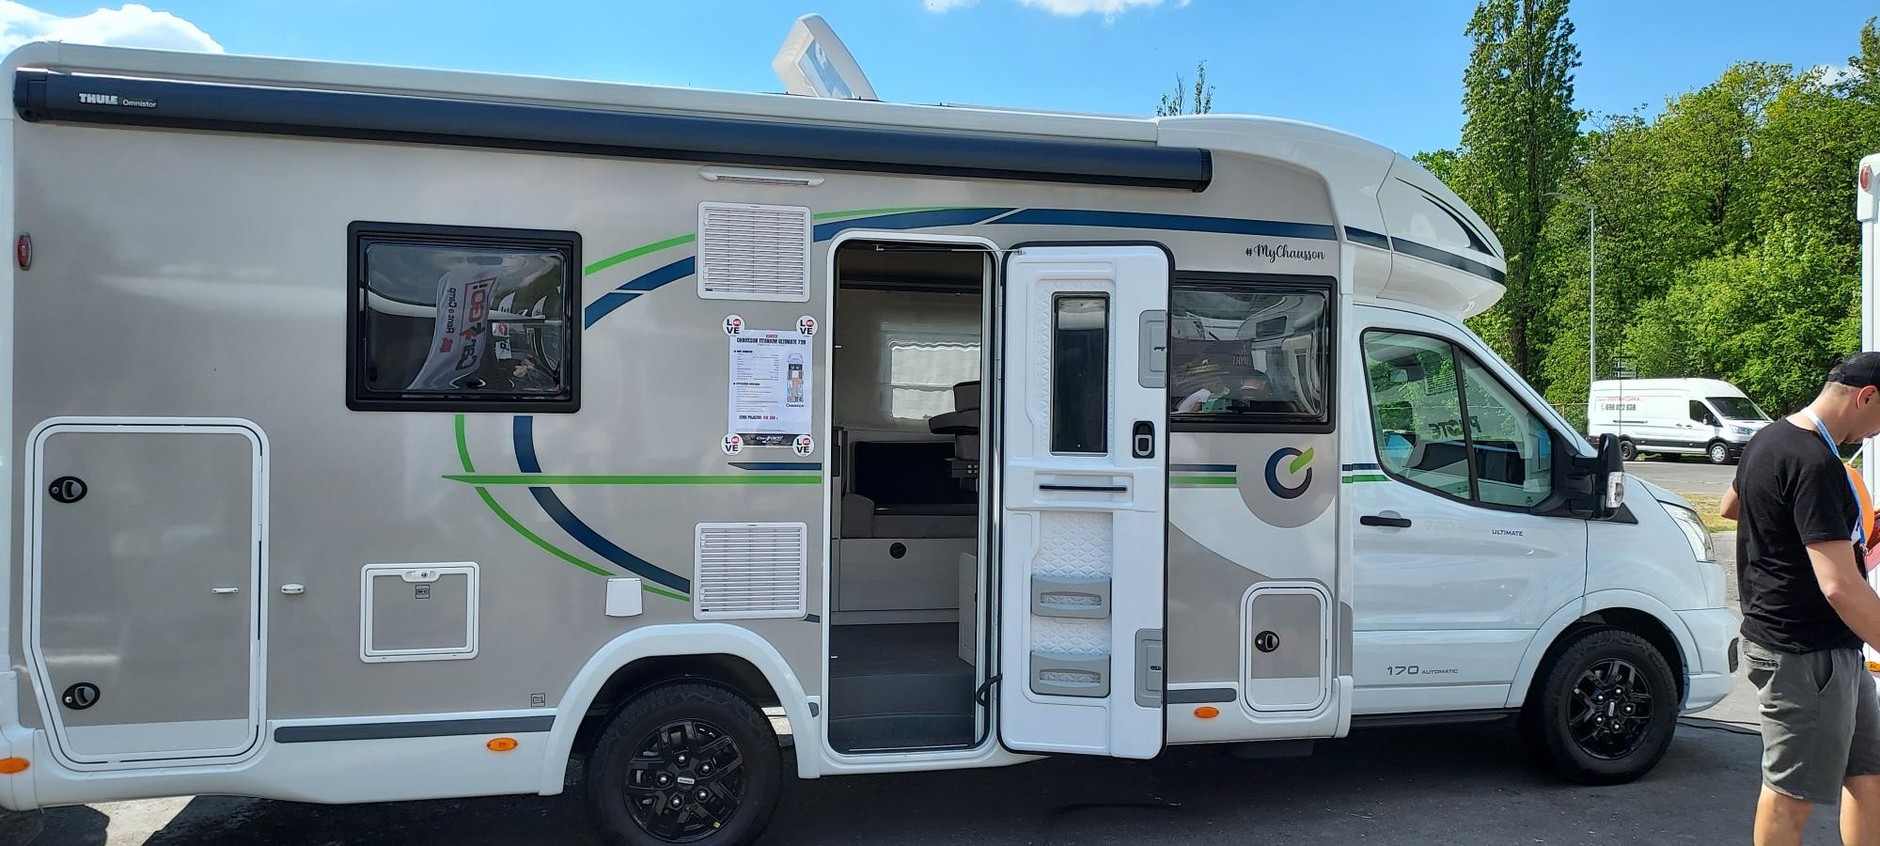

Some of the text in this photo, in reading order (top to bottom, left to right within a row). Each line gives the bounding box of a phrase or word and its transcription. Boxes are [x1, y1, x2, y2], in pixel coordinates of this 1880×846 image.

[79, 93, 157, 108] THULE Omnistor
[1245, 244, 1326, 263] #MyChausson
[1491, 529, 1524, 537] ULTIMATE
[1387, 665, 1419, 676] 170
